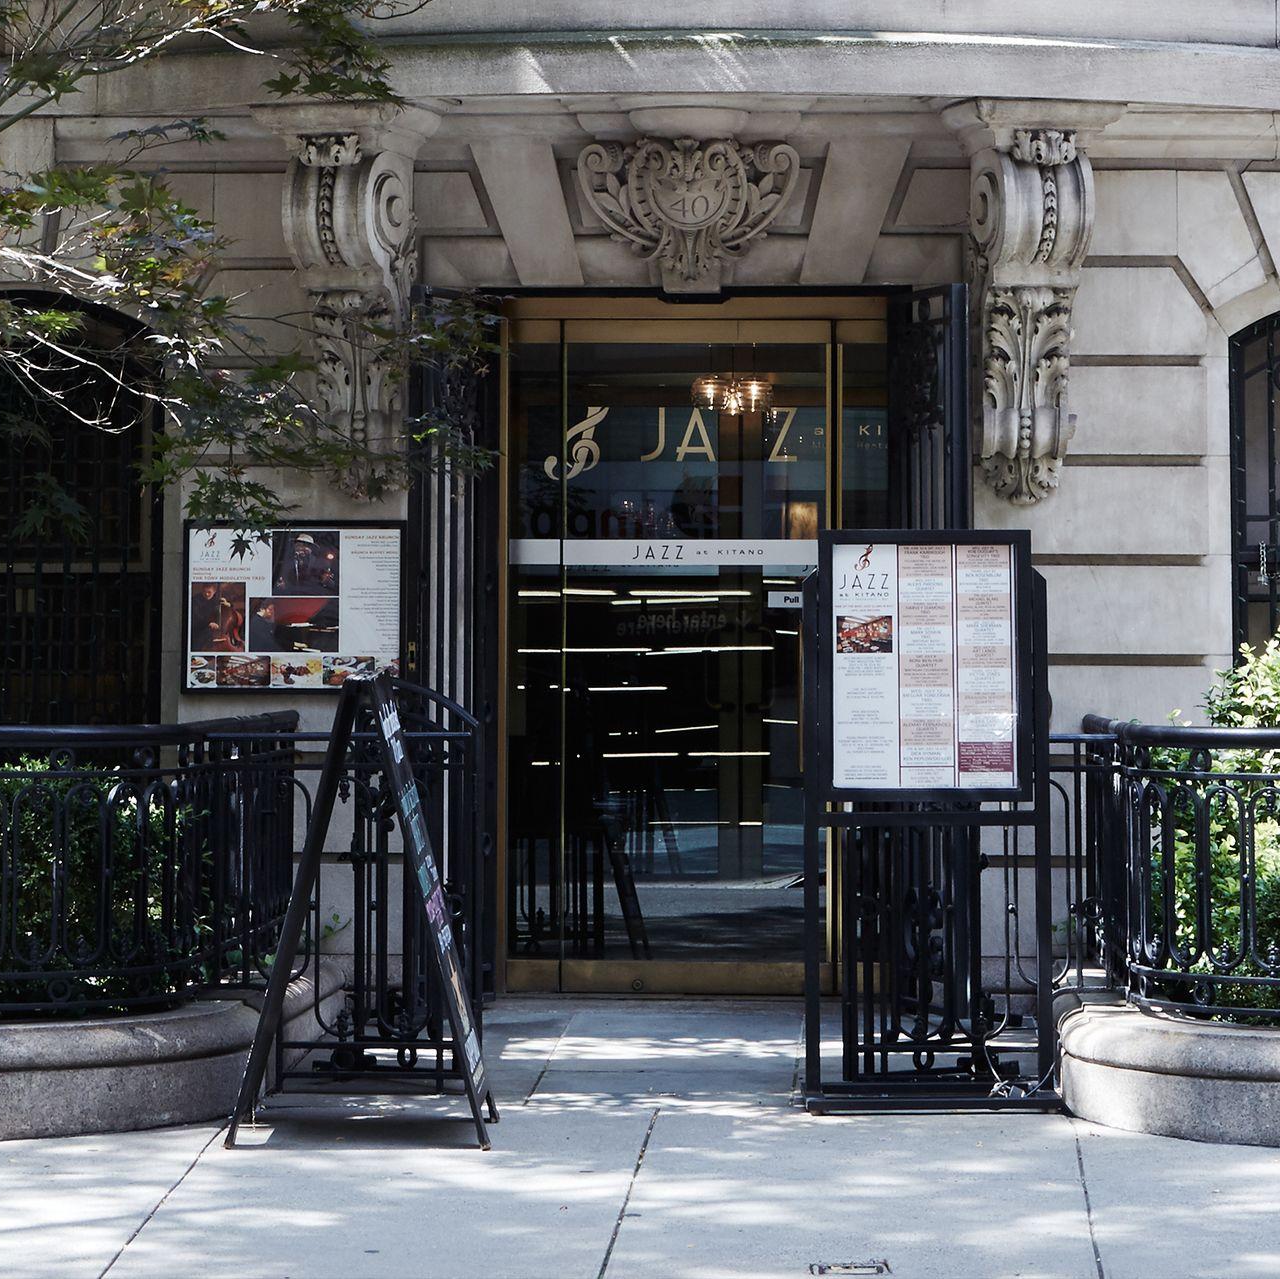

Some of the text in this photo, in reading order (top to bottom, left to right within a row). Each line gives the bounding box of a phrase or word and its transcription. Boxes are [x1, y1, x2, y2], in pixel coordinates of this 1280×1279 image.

[640, 407, 797, 462] JAZ
[632, 545, 683, 560] JAZZ
[839, 573, 888, 590] JAZZ
[784, 595, 800, 604] Pull
